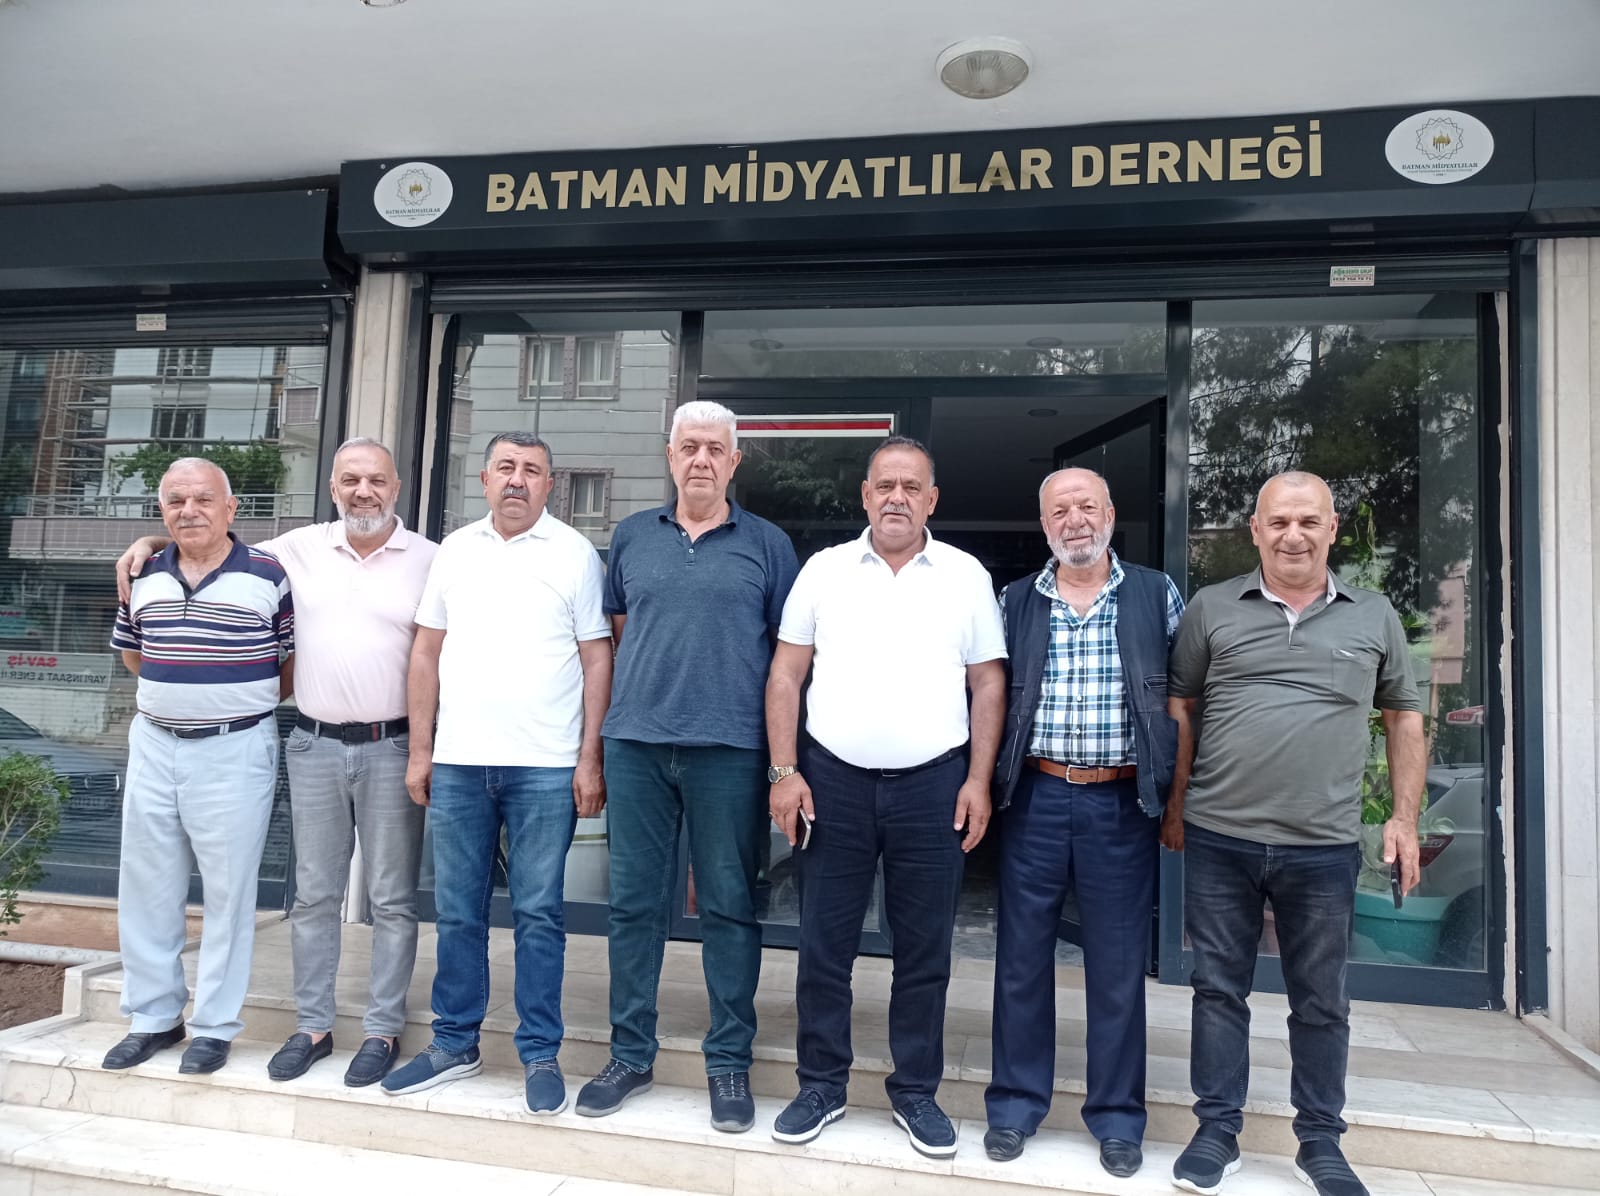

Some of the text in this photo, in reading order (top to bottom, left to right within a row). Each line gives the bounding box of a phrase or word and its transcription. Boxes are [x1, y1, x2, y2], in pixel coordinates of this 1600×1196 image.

[486, 119, 1322, 212] BATMAN MİDYATLILAR DERNEĞİ
